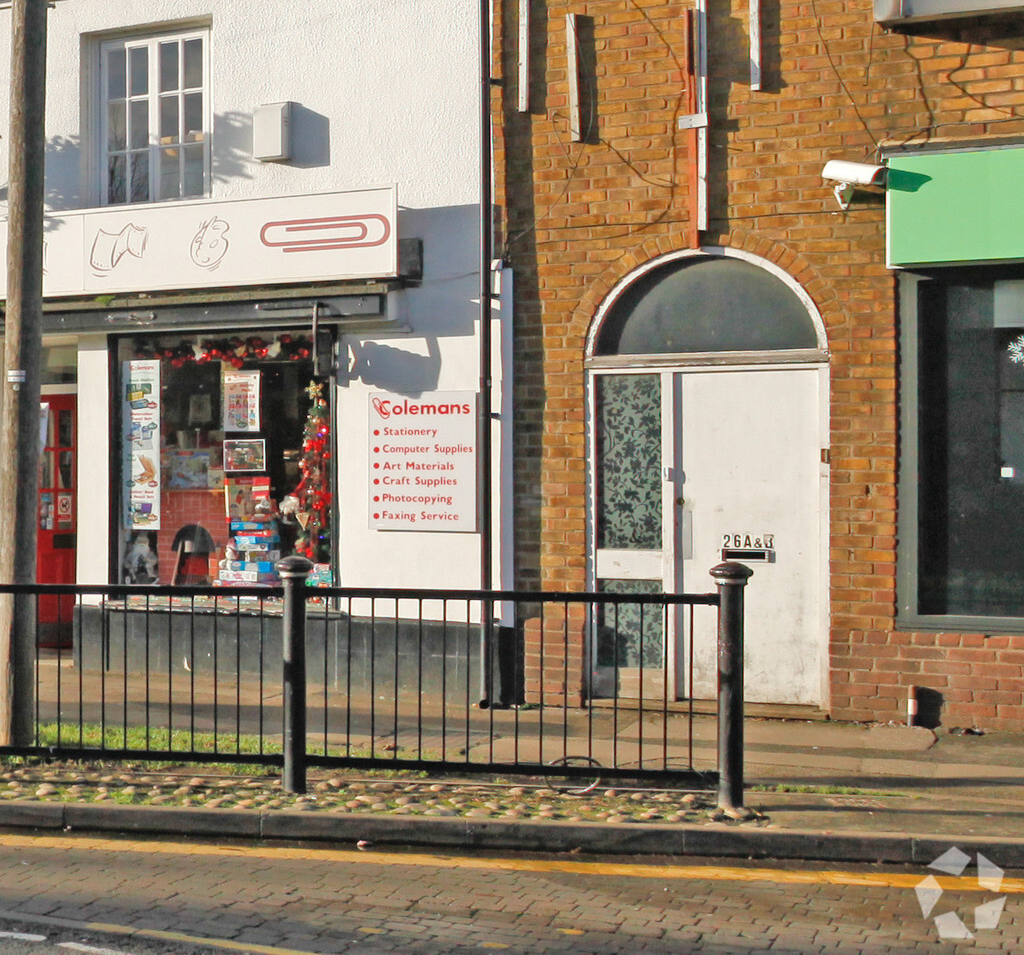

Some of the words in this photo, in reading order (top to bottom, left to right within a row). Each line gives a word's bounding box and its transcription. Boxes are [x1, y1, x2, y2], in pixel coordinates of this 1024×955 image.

[378, 399, 470, 415] Colemans
[383, 427, 437, 438] Stationery
[382, 445, 430, 455] Computer
[434, 444, 473, 455] Supplies
[383, 462, 402, 471] Art
[405, 462, 455, 471] Materials
[383, 476, 411, 486] Craft
[415, 476, 458, 487] Supplies
[382, 493, 452, 505] Photocopying
[382, 511, 416, 522] Faxing
[421, 511, 459, 521] Service
